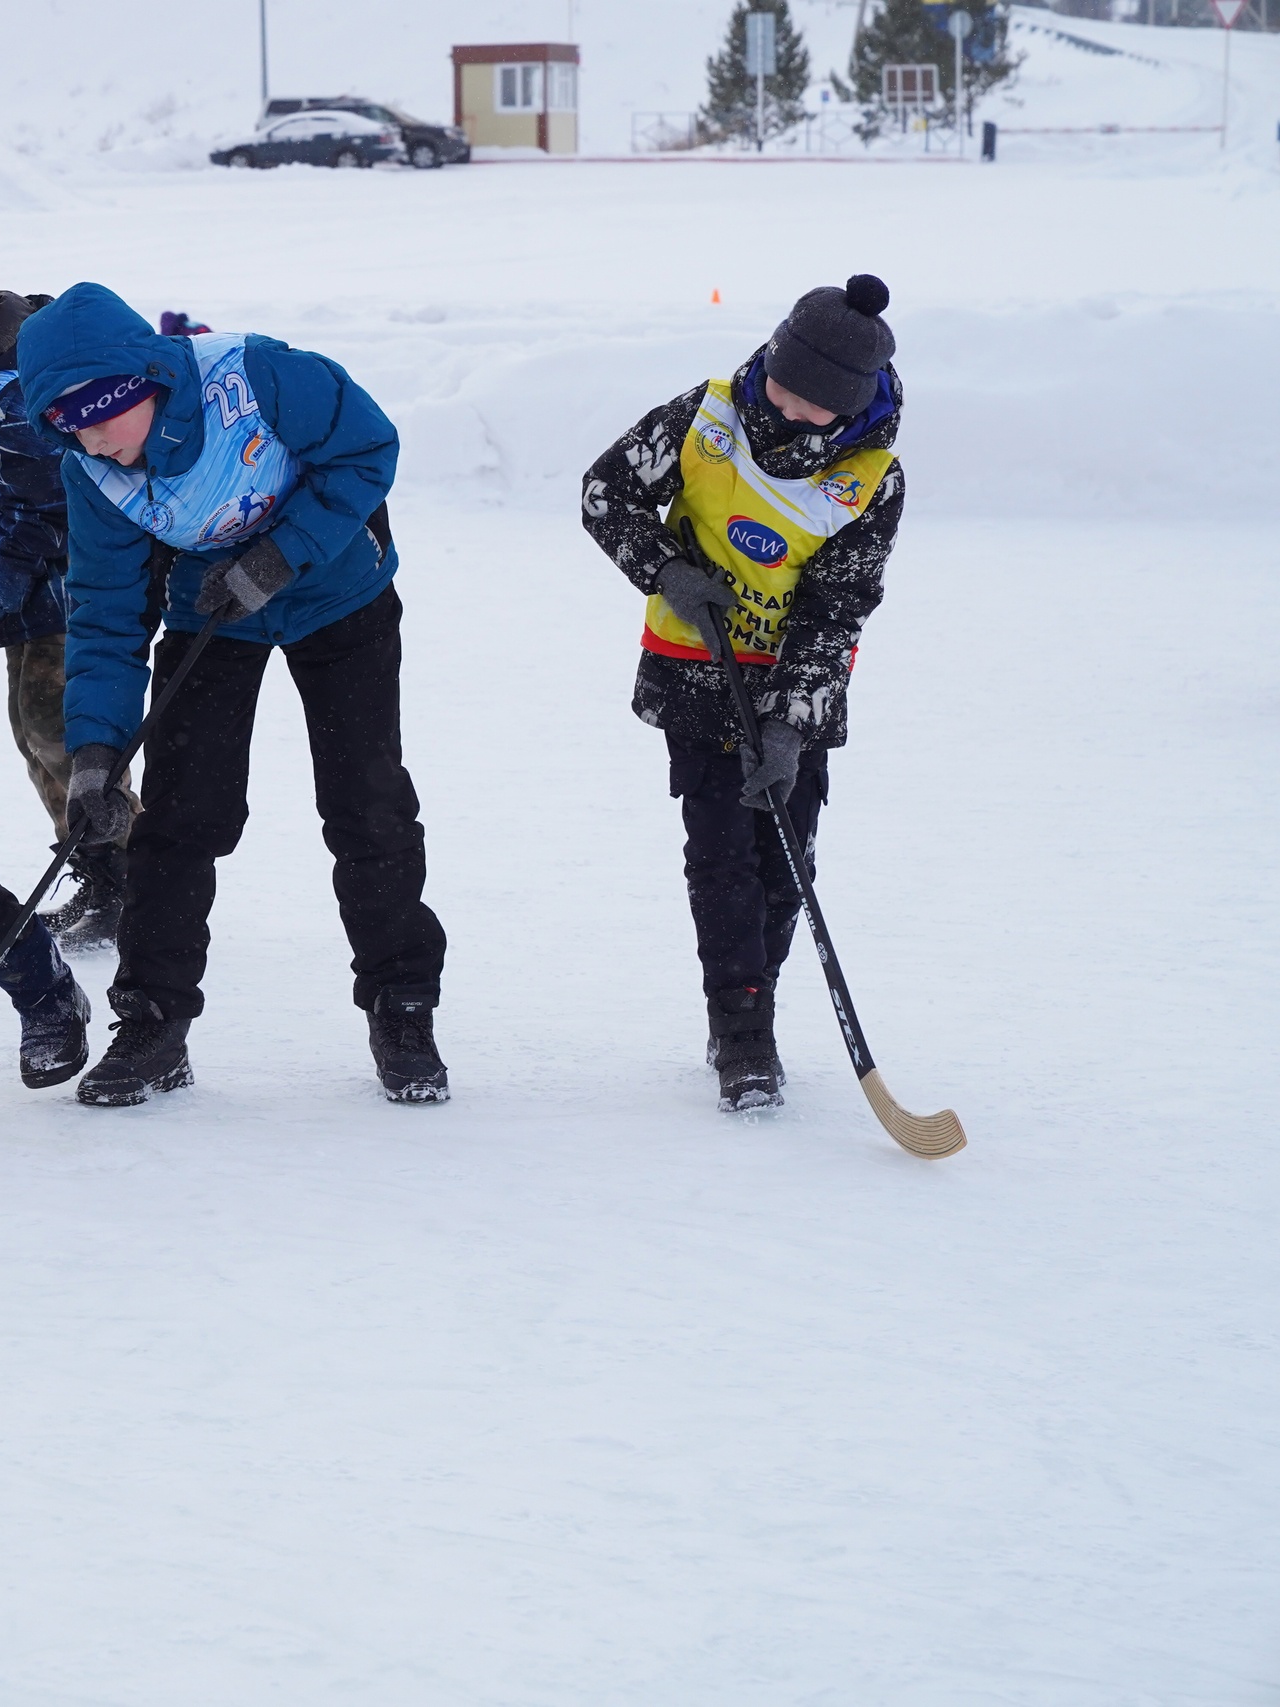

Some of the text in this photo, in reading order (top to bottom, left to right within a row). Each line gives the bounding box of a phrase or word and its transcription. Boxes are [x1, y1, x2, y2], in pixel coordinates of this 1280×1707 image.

[81, 375, 146, 419] РОСС
[205, 371, 260, 430] 22
[730, 527, 784, 555] NCW
[740, 582, 798, 611] LEAD
[778, 827, 803, 893] ORANGE
[801, 897, 817, 934] HAIL
[830, 988, 864, 1067] STEX
